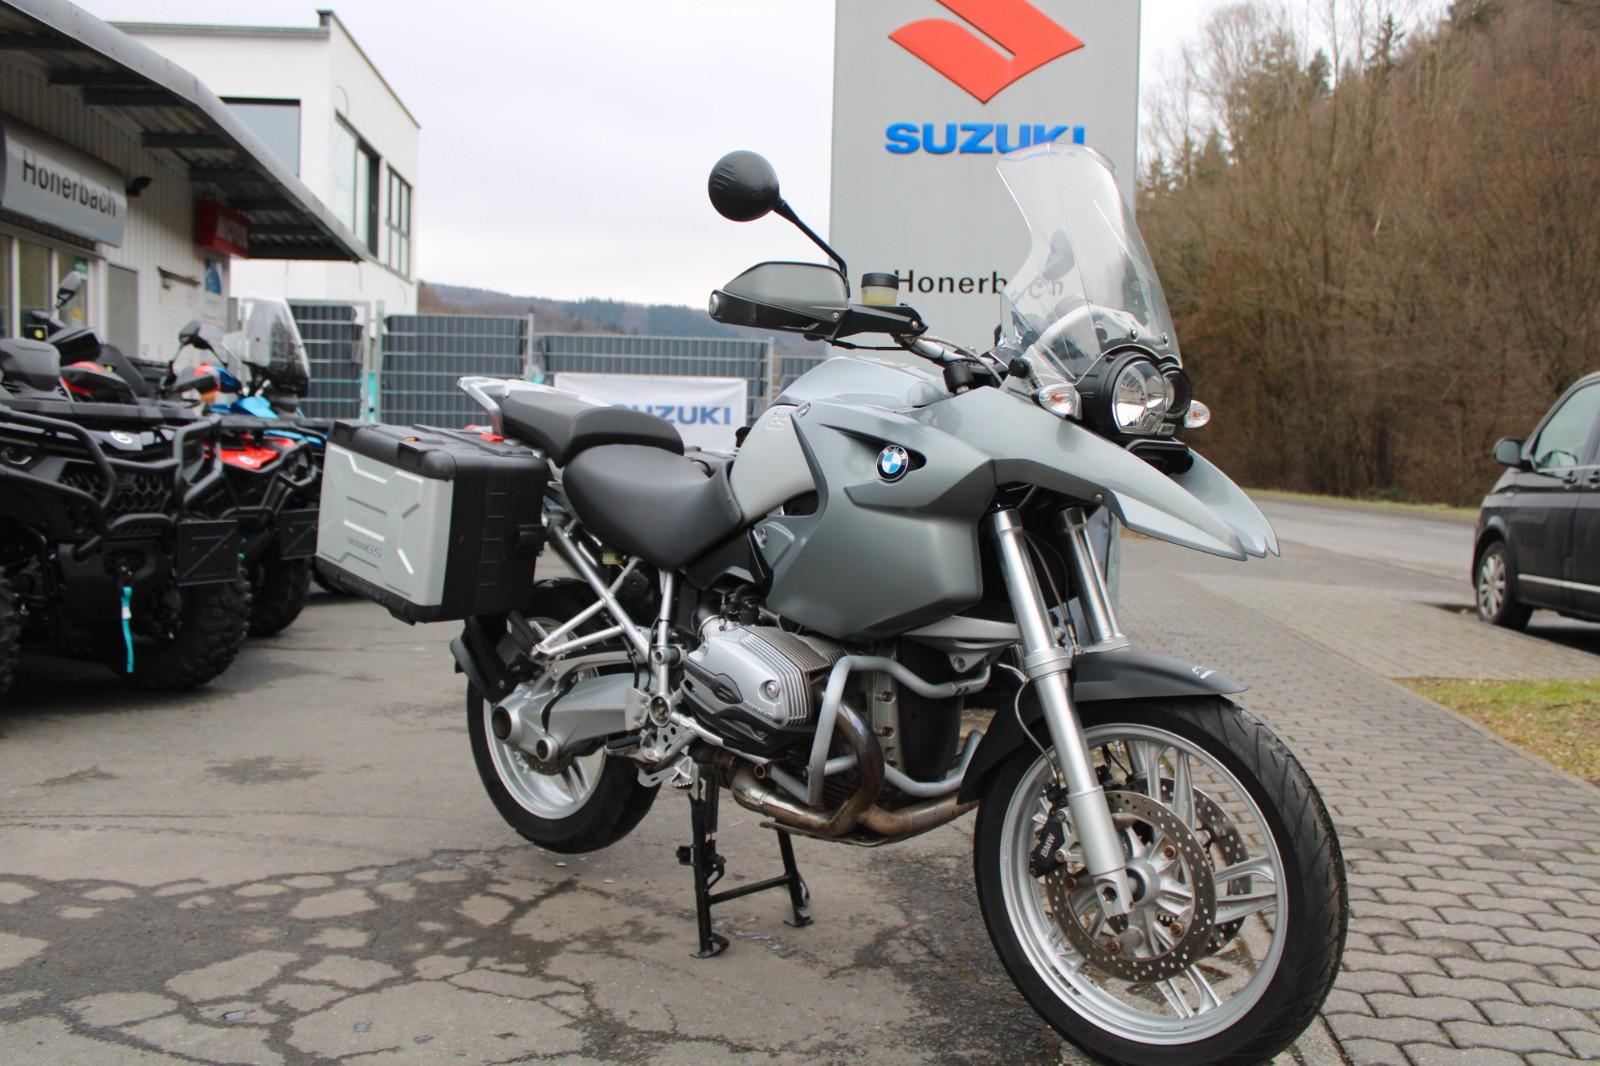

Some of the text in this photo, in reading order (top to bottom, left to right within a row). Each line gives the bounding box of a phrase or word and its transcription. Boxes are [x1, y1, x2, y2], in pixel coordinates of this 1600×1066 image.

[885, 122, 1086, 154] SUZUKI
[22, 150, 117, 218] Honerbach
[894, 269, 1065, 299] Honerbch
[1040, 832, 1056, 858] BMW
